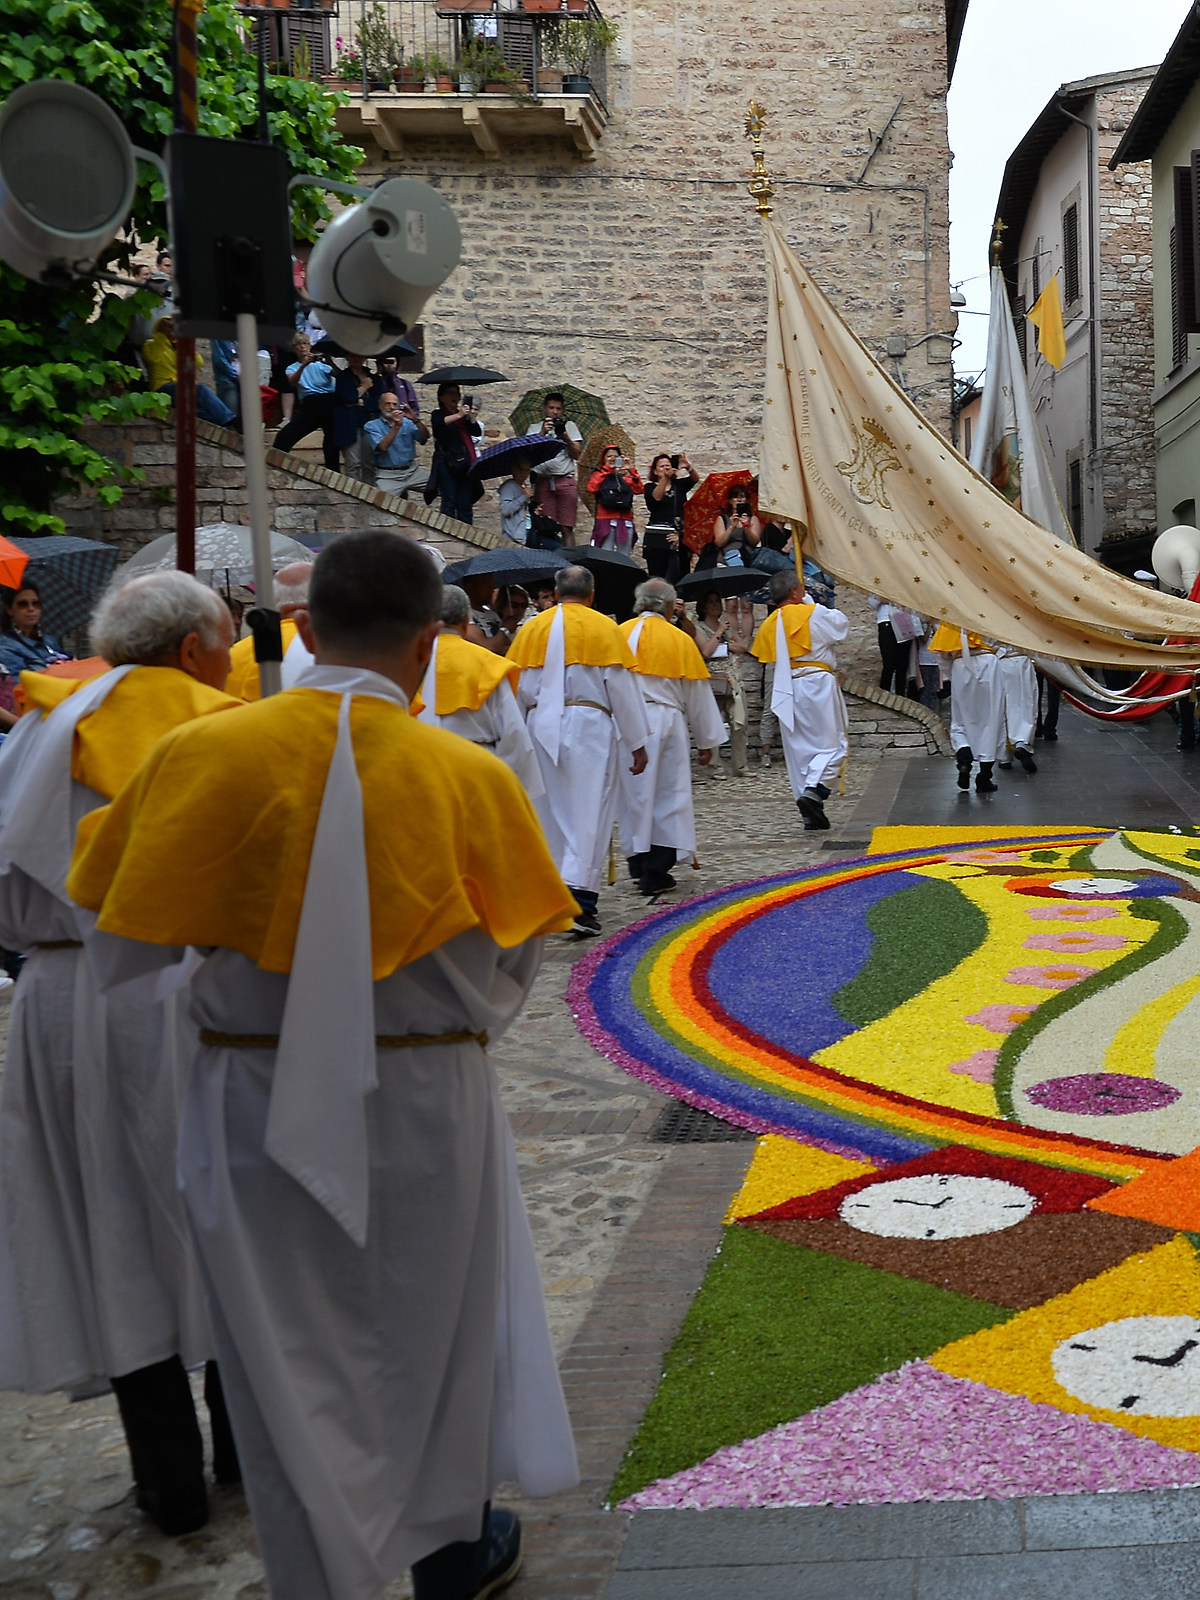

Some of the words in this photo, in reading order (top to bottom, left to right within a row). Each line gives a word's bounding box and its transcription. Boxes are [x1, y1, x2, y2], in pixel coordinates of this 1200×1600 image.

[798, 369, 811, 438] VENERABILE
[801, 445, 848, 520] CONFRATERNITA
[848, 516, 863, 534] DEL
